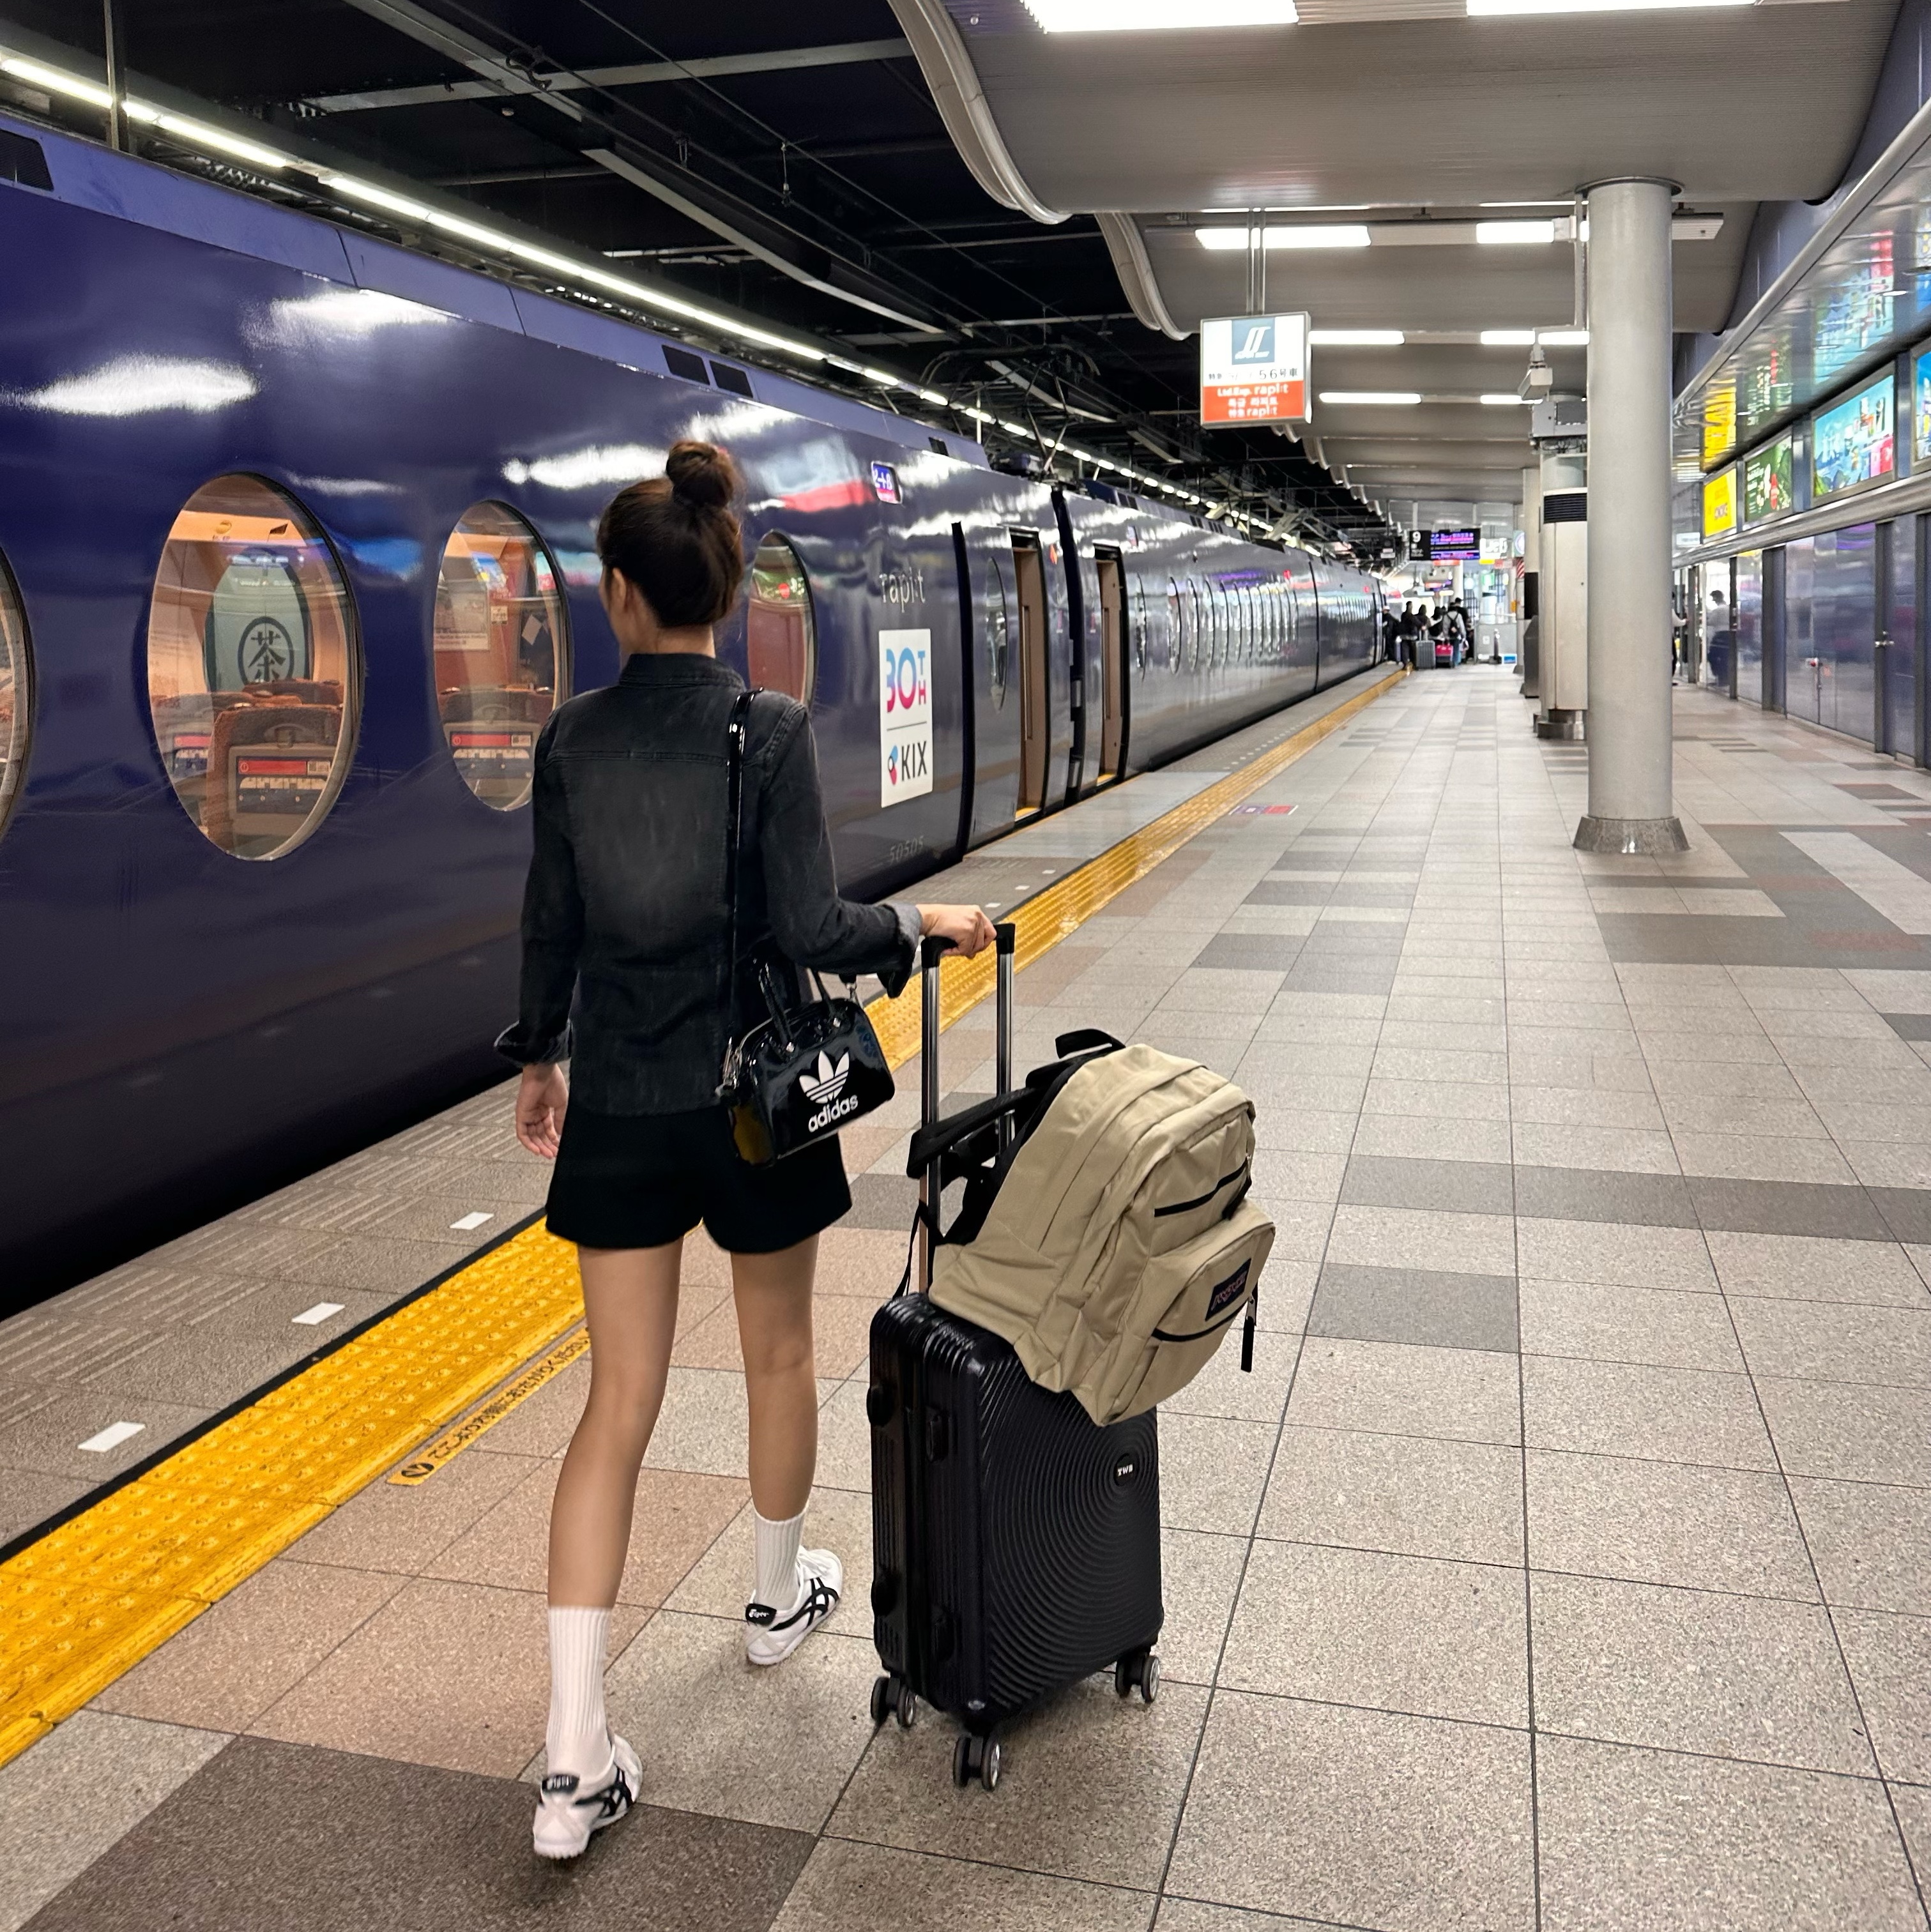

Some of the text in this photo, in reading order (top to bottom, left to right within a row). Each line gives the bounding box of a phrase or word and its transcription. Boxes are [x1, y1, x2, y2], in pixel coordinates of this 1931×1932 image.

[1412, 531, 1421, 543] 9
[248, 630, 287, 682] 茶
[901, 741, 927, 781] KIX
[808, 1095, 859, 1132] adidas
